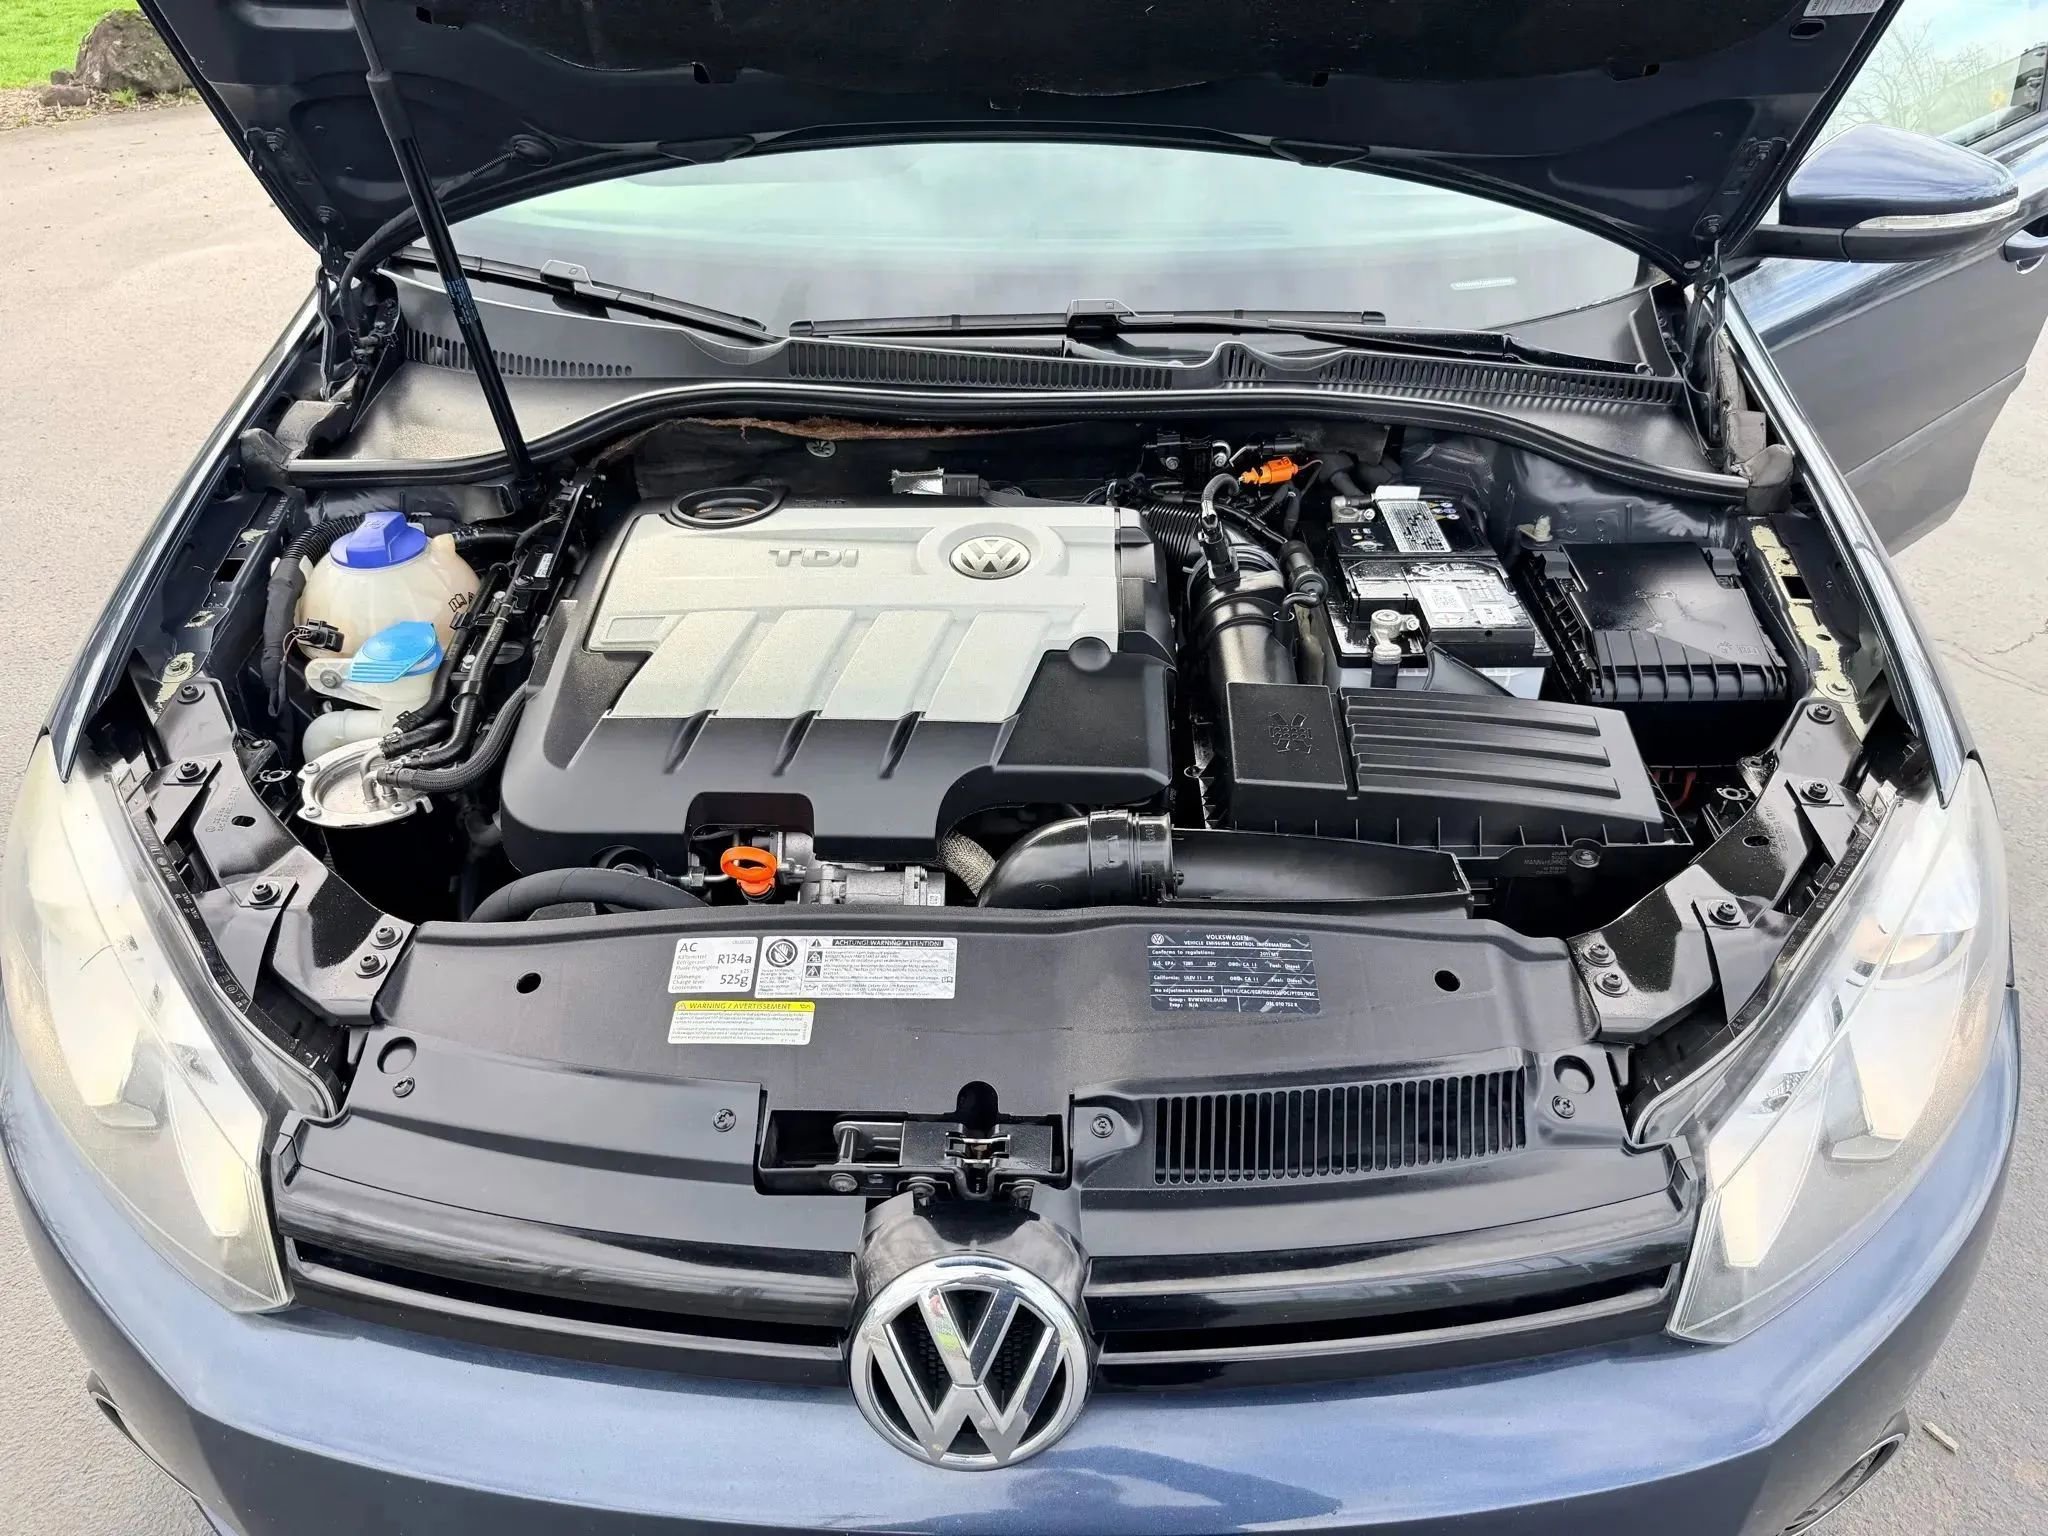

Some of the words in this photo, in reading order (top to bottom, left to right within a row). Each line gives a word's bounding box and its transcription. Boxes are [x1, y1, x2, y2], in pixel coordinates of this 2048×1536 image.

[769, 548, 859, 568] TDI
[680, 942, 698, 953] AC
[905, 940, 942, 948] ATTENTION!
[717, 953, 752, 965] R134a
[720, 974, 748, 988] 525g
[689, 1002, 726, 1010] WARNING
